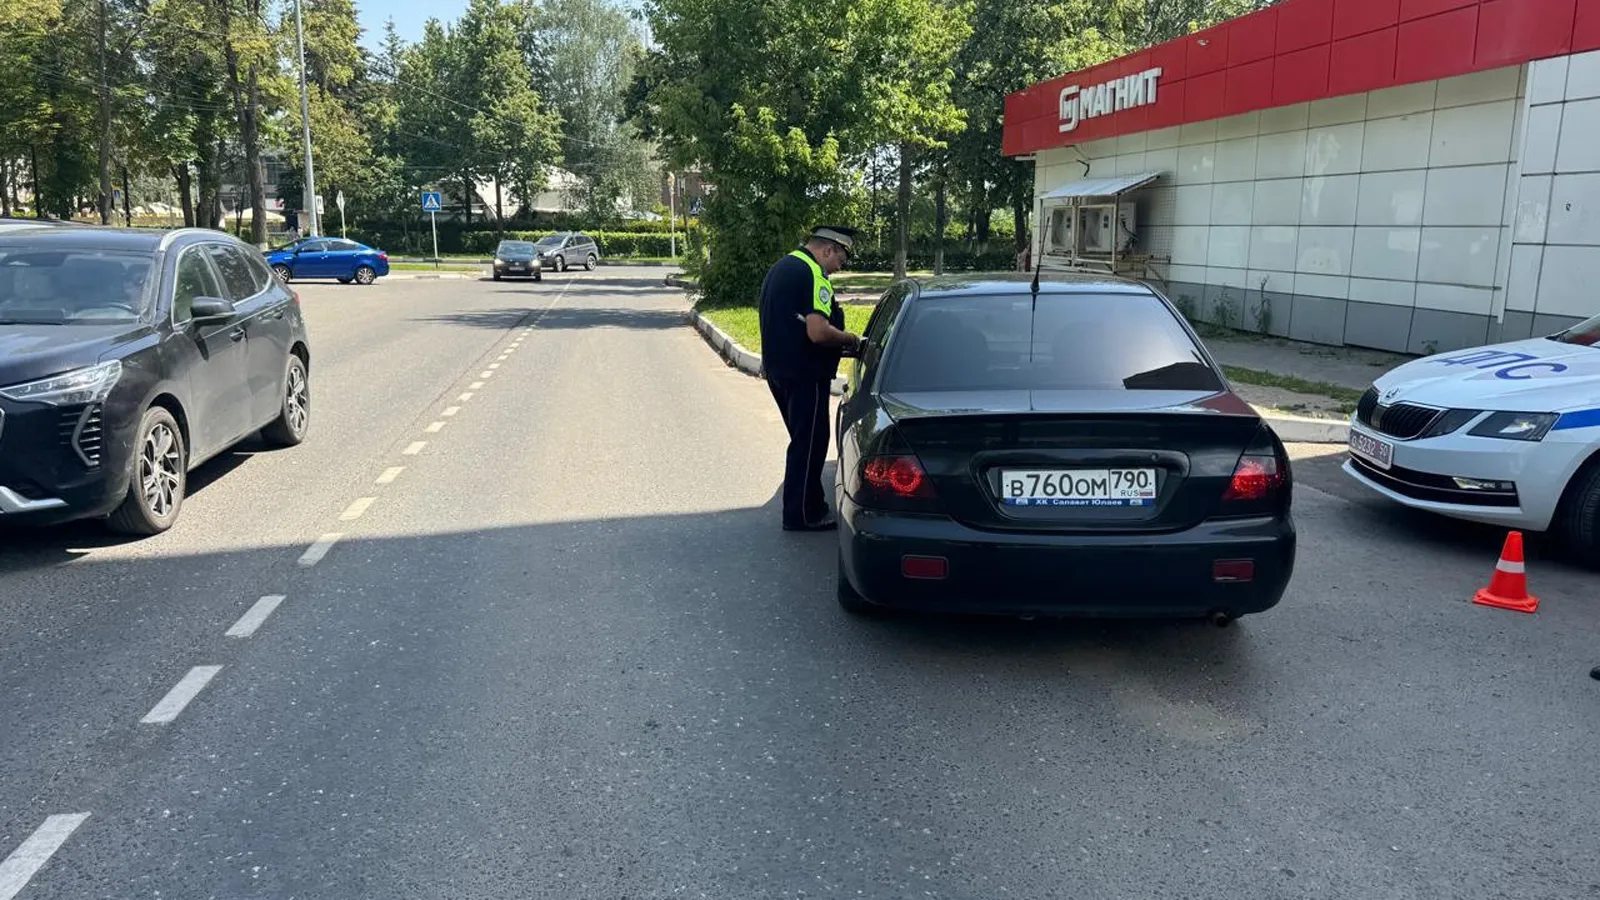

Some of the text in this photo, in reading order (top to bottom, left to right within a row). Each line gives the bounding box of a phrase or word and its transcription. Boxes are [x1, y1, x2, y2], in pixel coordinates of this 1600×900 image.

[1080, 67, 1162, 120] МАГНИТ
[1430, 350, 1568, 380] ДПС
[1010, 471, 1149, 497] В760ОМ 790
[1120, 489, 1140, 497] RUS
